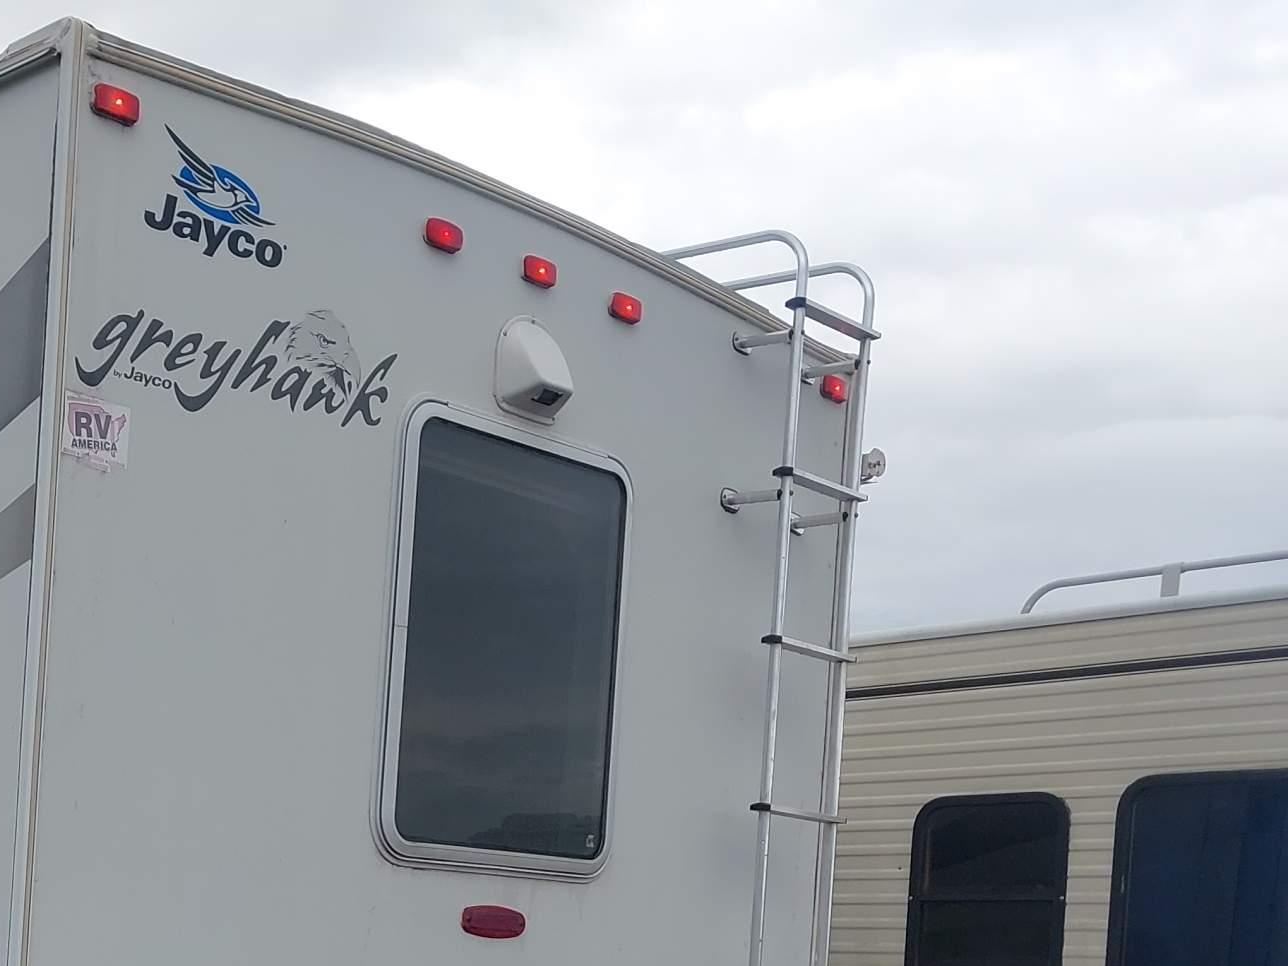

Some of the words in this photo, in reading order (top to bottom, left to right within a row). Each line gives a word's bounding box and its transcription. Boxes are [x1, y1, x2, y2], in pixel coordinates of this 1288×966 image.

[143, 193, 283, 268] Jayco
[74, 308, 399, 427] greyhawk
[123, 366, 173, 390] Jayco
[74, 411, 112, 440] RV
[71, 438, 118, 452] AMERICA
